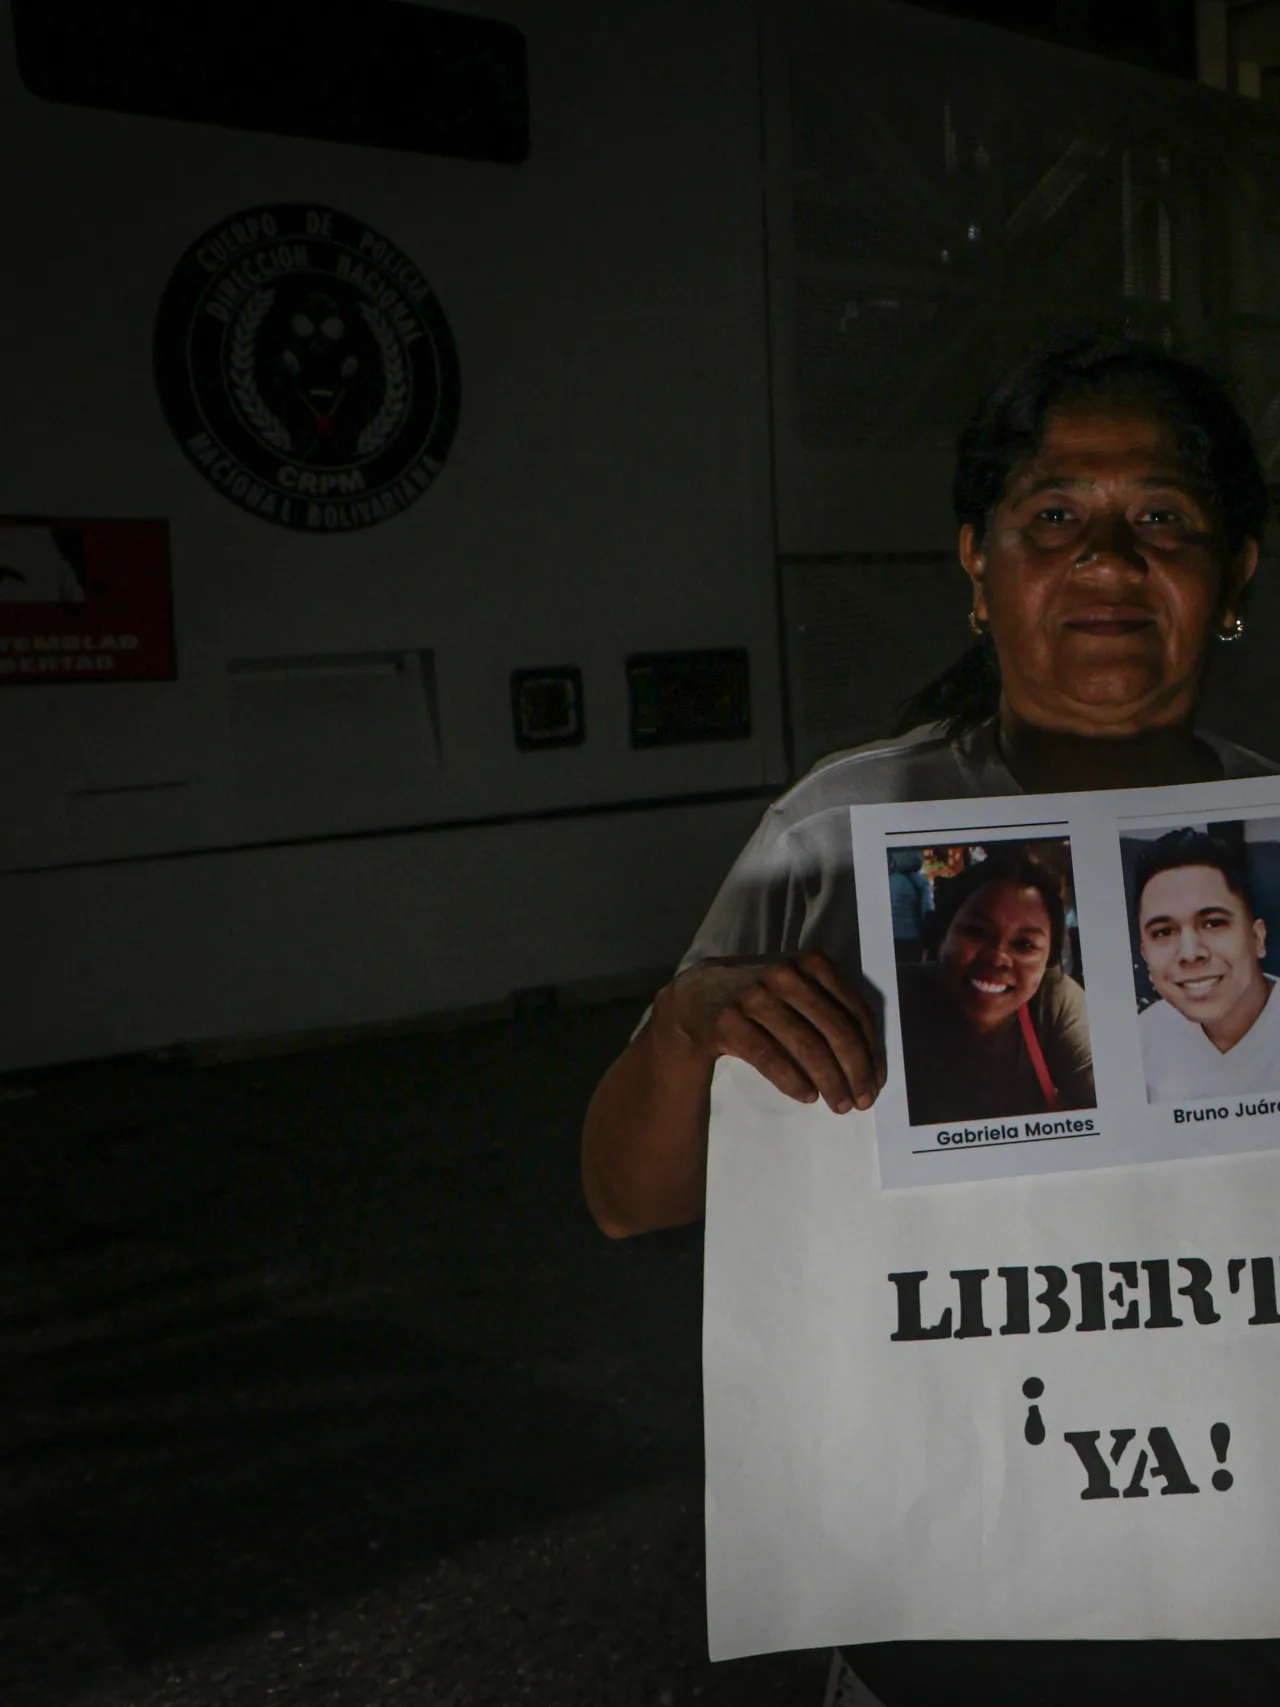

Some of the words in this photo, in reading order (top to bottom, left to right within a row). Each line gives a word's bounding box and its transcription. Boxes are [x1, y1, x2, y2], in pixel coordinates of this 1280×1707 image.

[196, 210, 278, 272] CUERPO
[305, 210, 334, 236] DE
[185, 430, 292, 524] NACIONAL
[306, 453, 446, 529] BOLIVARIANA
[936, 1122, 1019, 1147] Gabriela
[1025, 1116, 1095, 1137] Montes
[1174, 1105, 1229, 1123] Bruno
